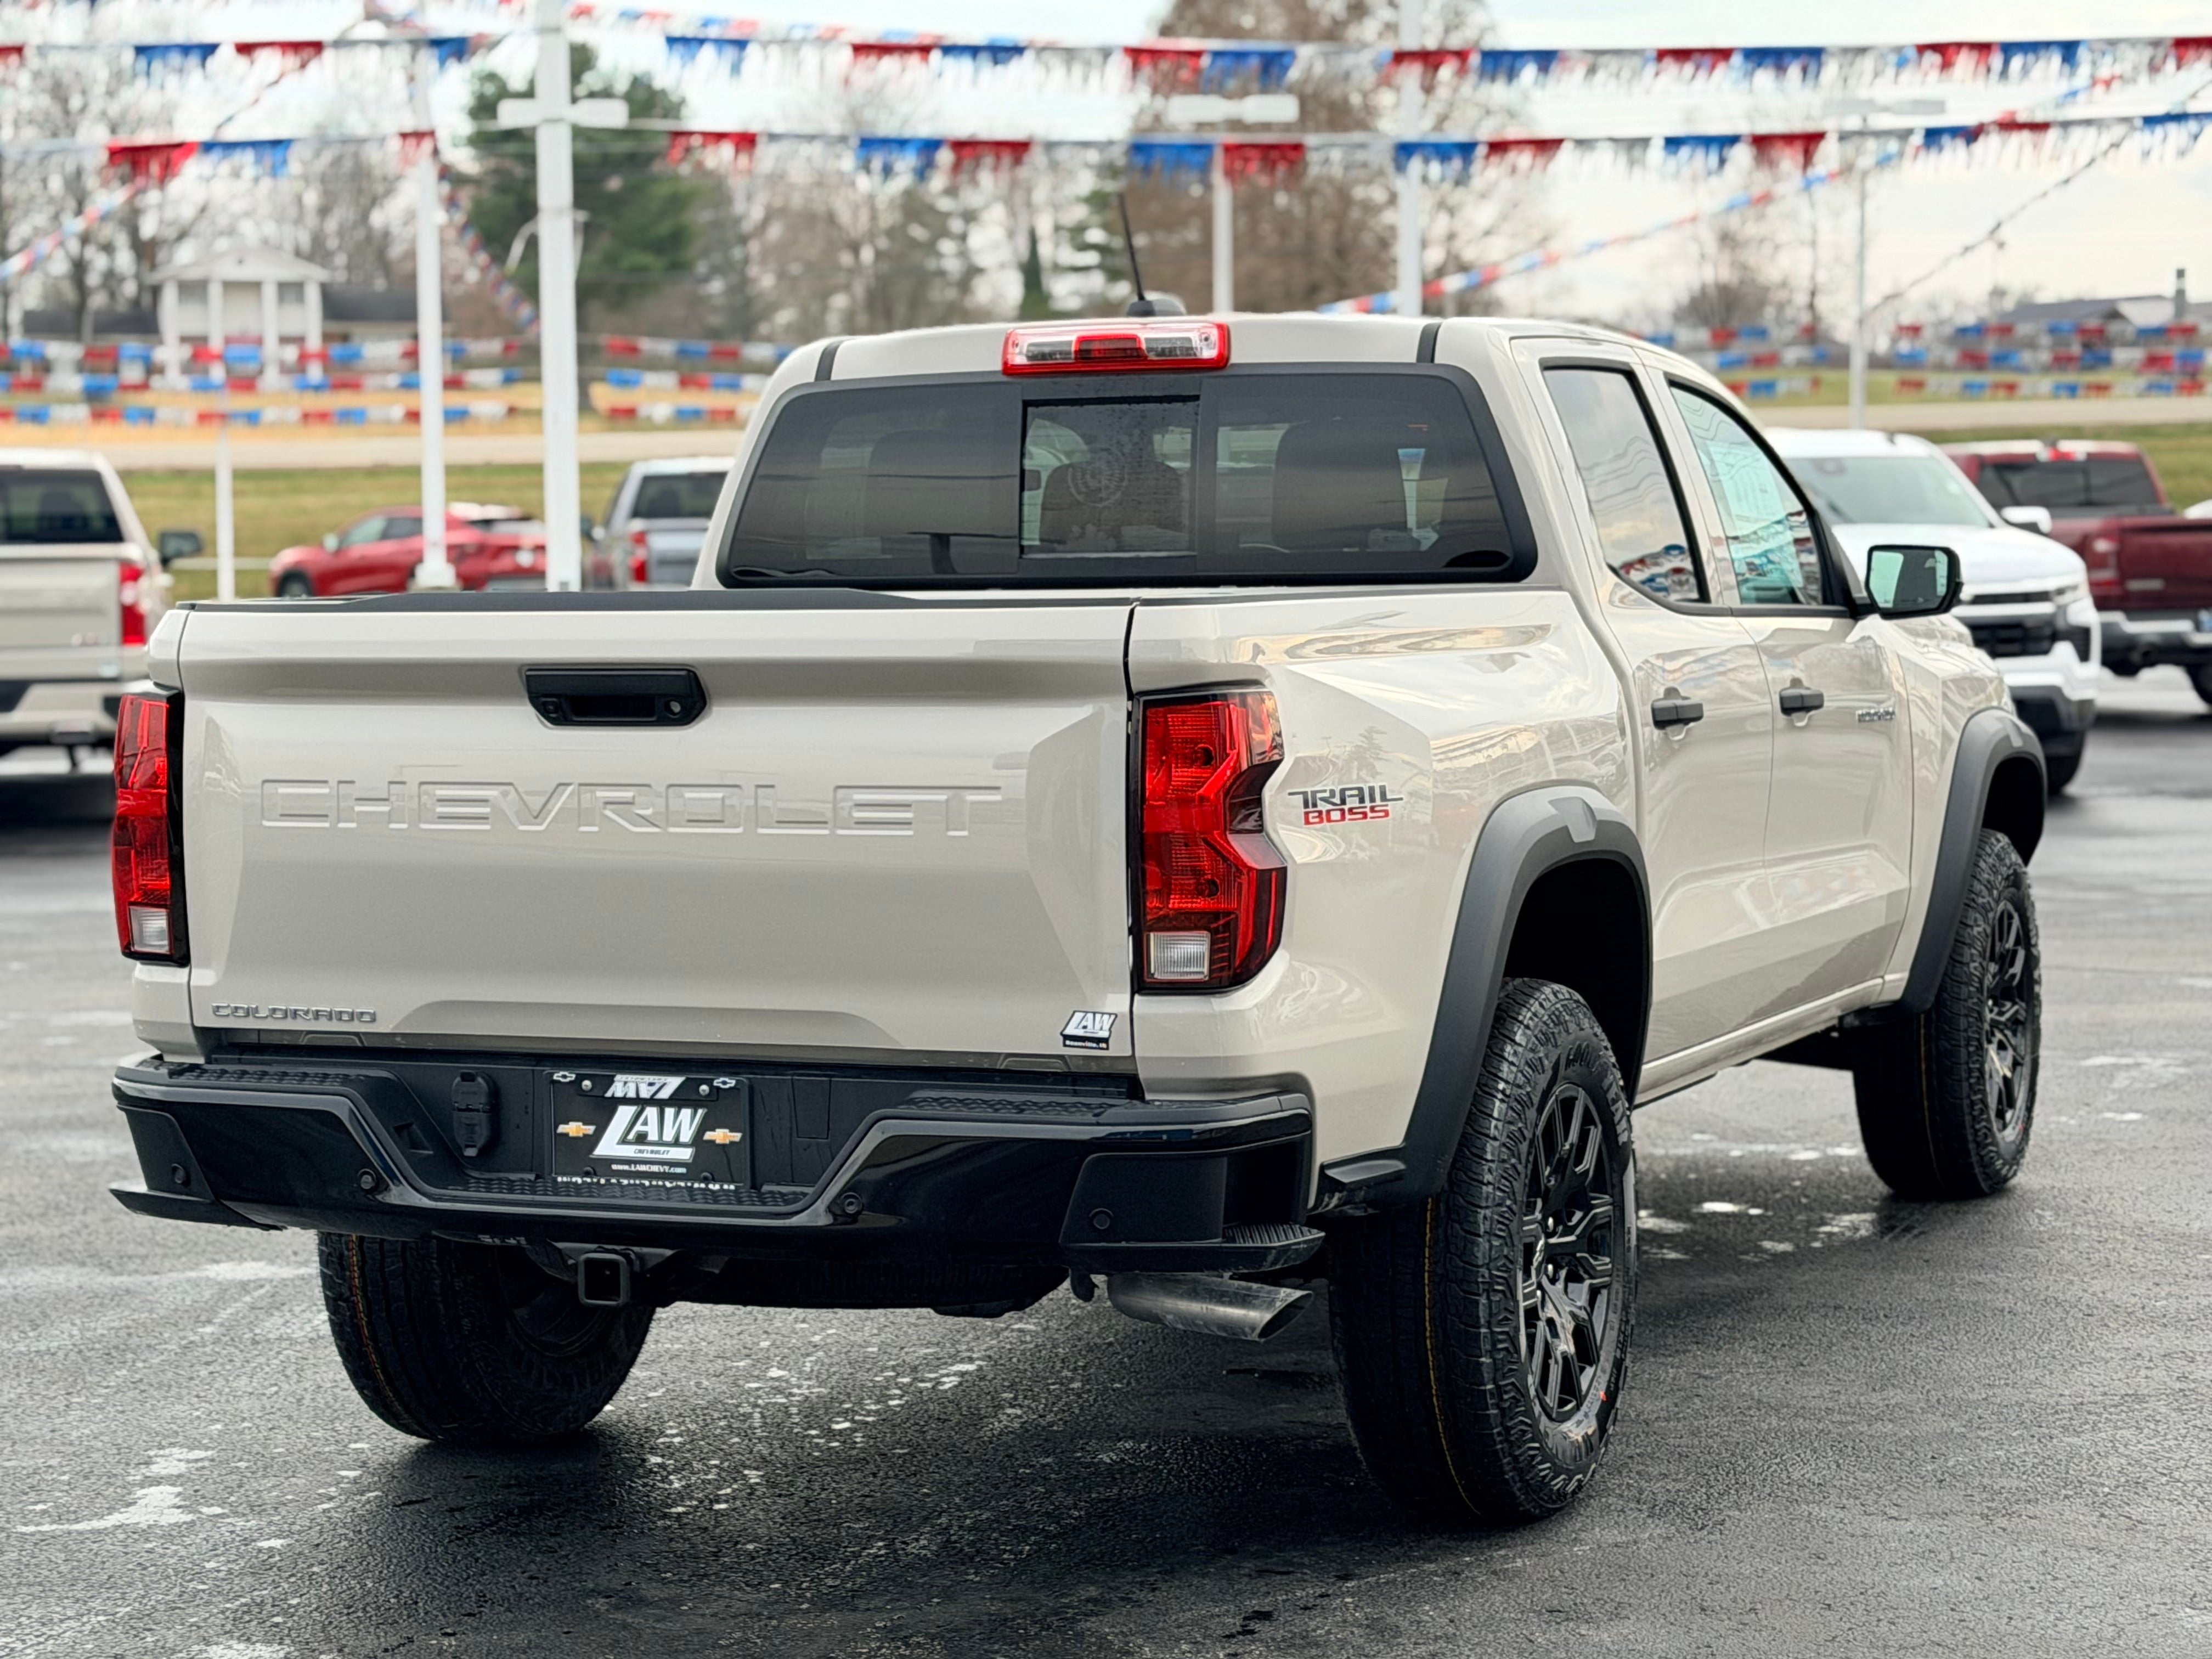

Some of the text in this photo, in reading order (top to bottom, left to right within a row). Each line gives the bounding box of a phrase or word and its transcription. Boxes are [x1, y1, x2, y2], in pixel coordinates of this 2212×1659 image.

[261, 778, 1002, 836] CHEVROLET
[1288, 785, 1403, 809] TRAIL
[1304, 804, 1389, 825] BOSS
[211, 1003, 376, 1022] COLORADO
[1063, 1012, 1116, 1037] LAW
[591, 1104, 707, 1161] LAW
[611, 1164, 687, 1173] www.LAWCHEVY.com
